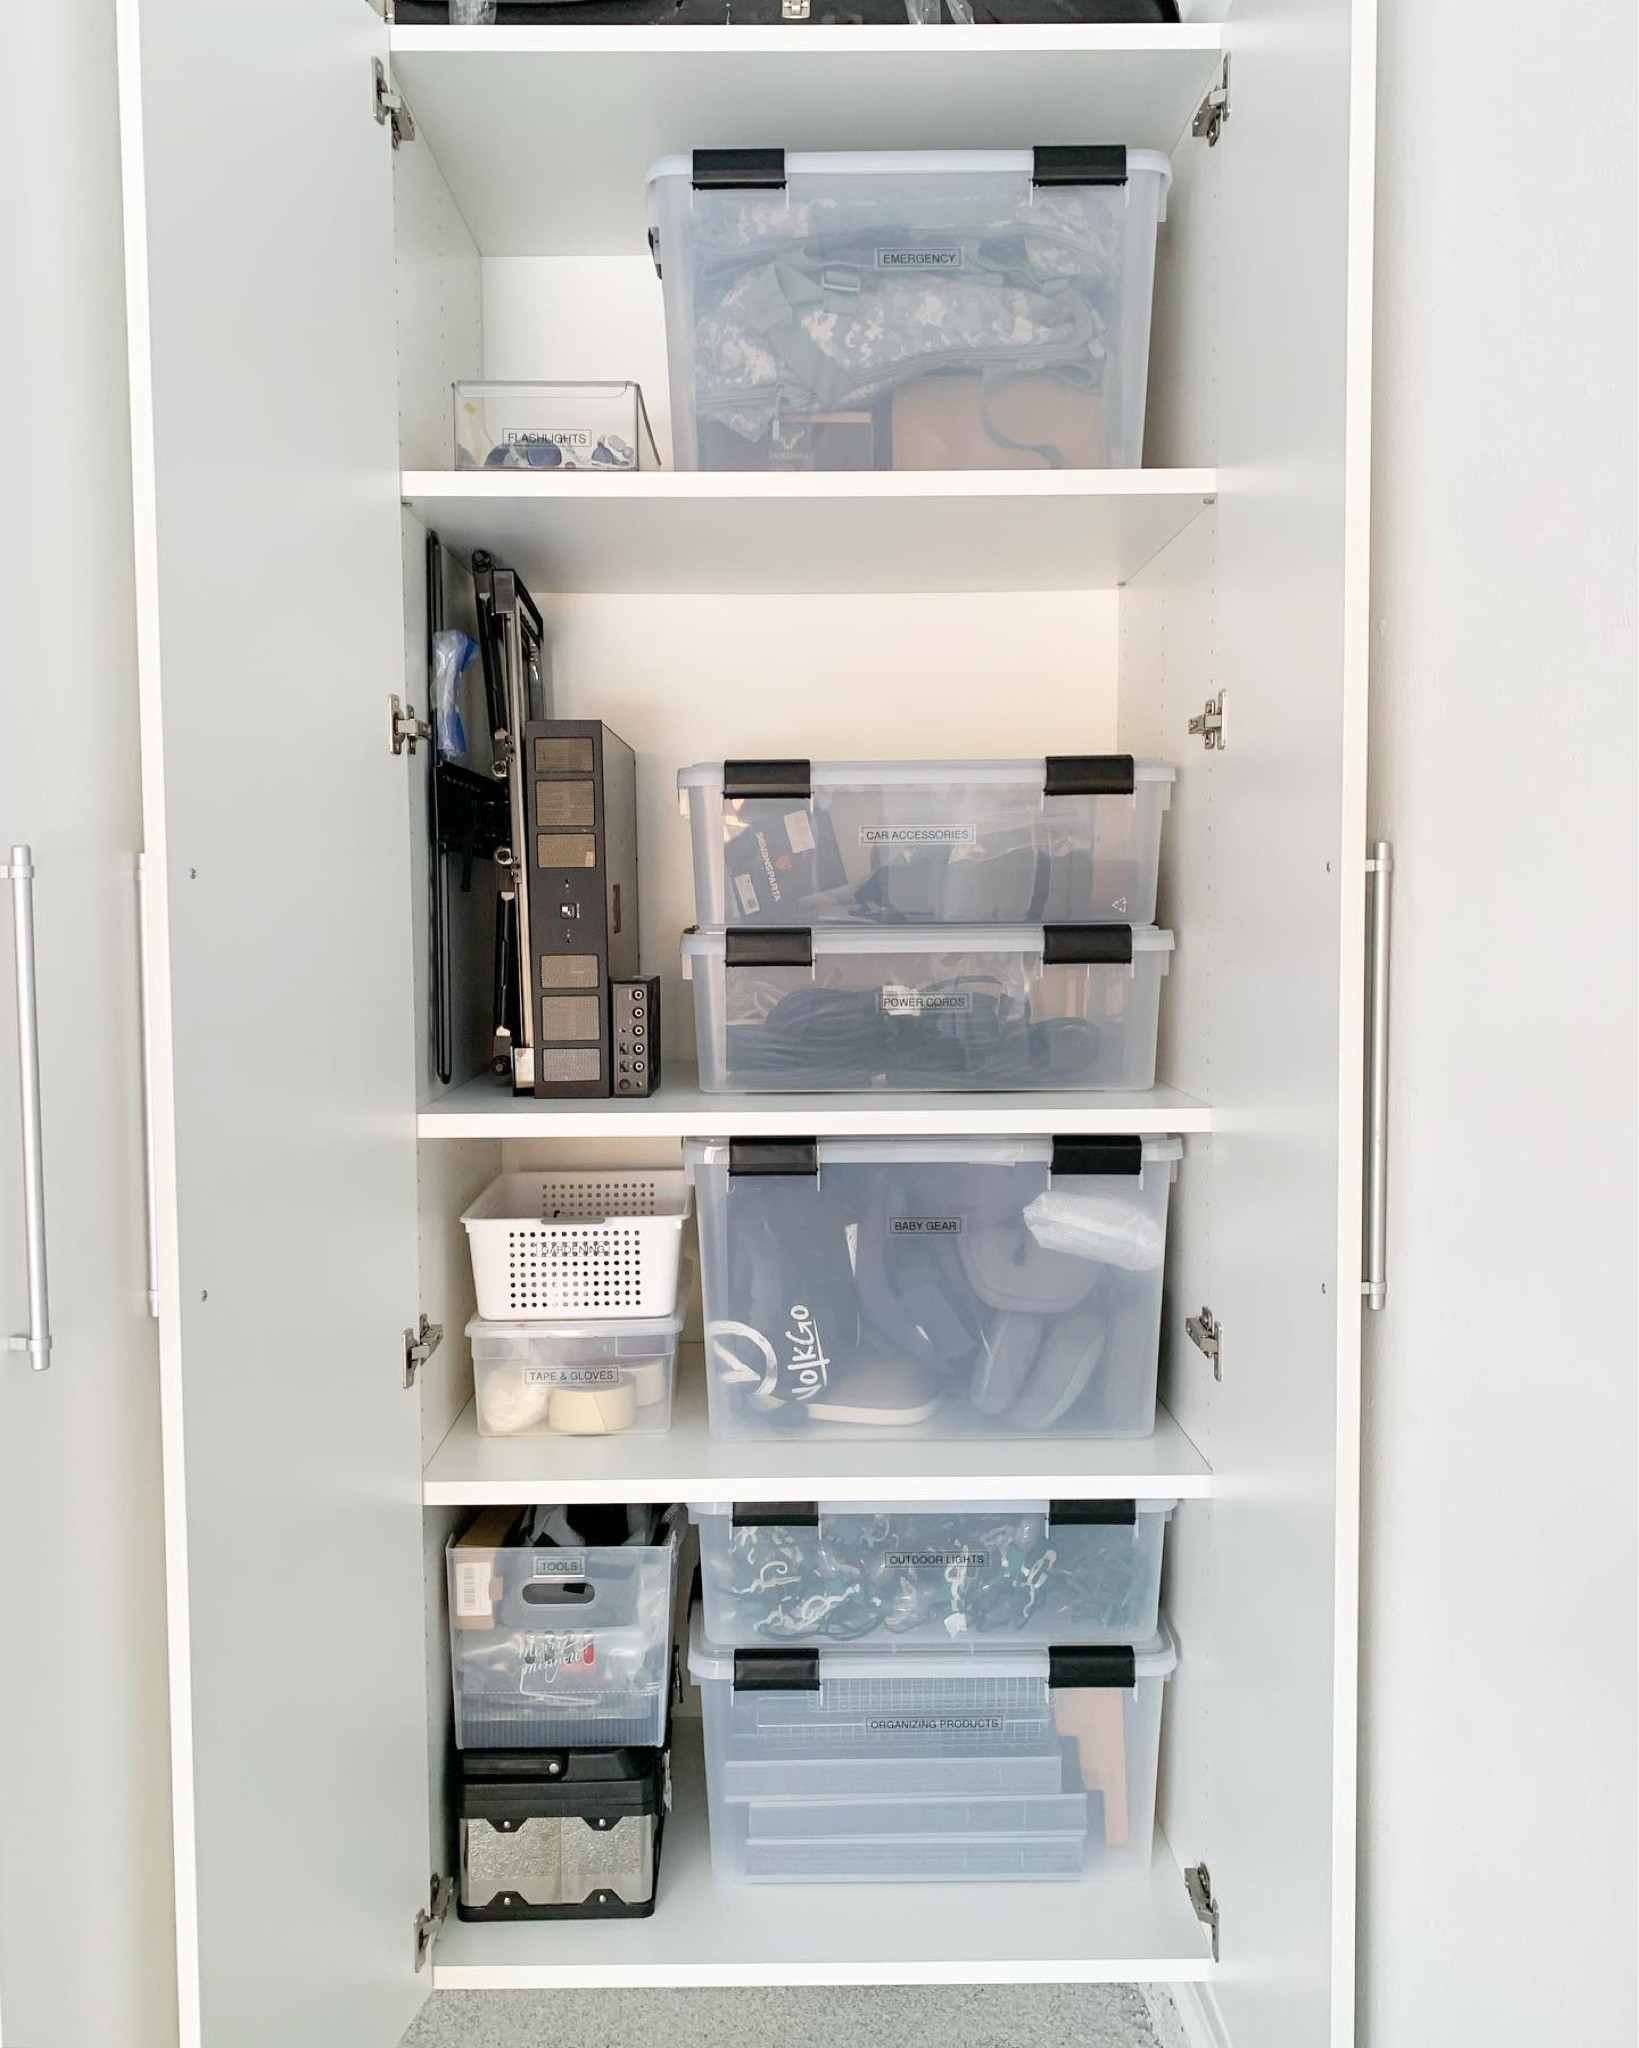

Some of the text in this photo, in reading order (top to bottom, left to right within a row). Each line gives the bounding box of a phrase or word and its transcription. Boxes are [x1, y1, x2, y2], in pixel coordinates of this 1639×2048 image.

[883, 253, 956, 265] EMERGENCY
[508, 432, 587, 444] FLASHLIGHTS
[866, 829, 969, 841] CAR ACCESSORIES
[883, 997, 965, 1008] POWER CORDS
[894, 1221, 957, 1231] BABY GEAR
[529, 1370, 614, 1381] TAPE & GLOVES
[889, 1554, 985, 1565] OUTDOOR LIGHTS
[541, 1561, 578, 1571] TOOLS
[870, 1718, 1000, 1729] ORGANIZING PRODUCTS
